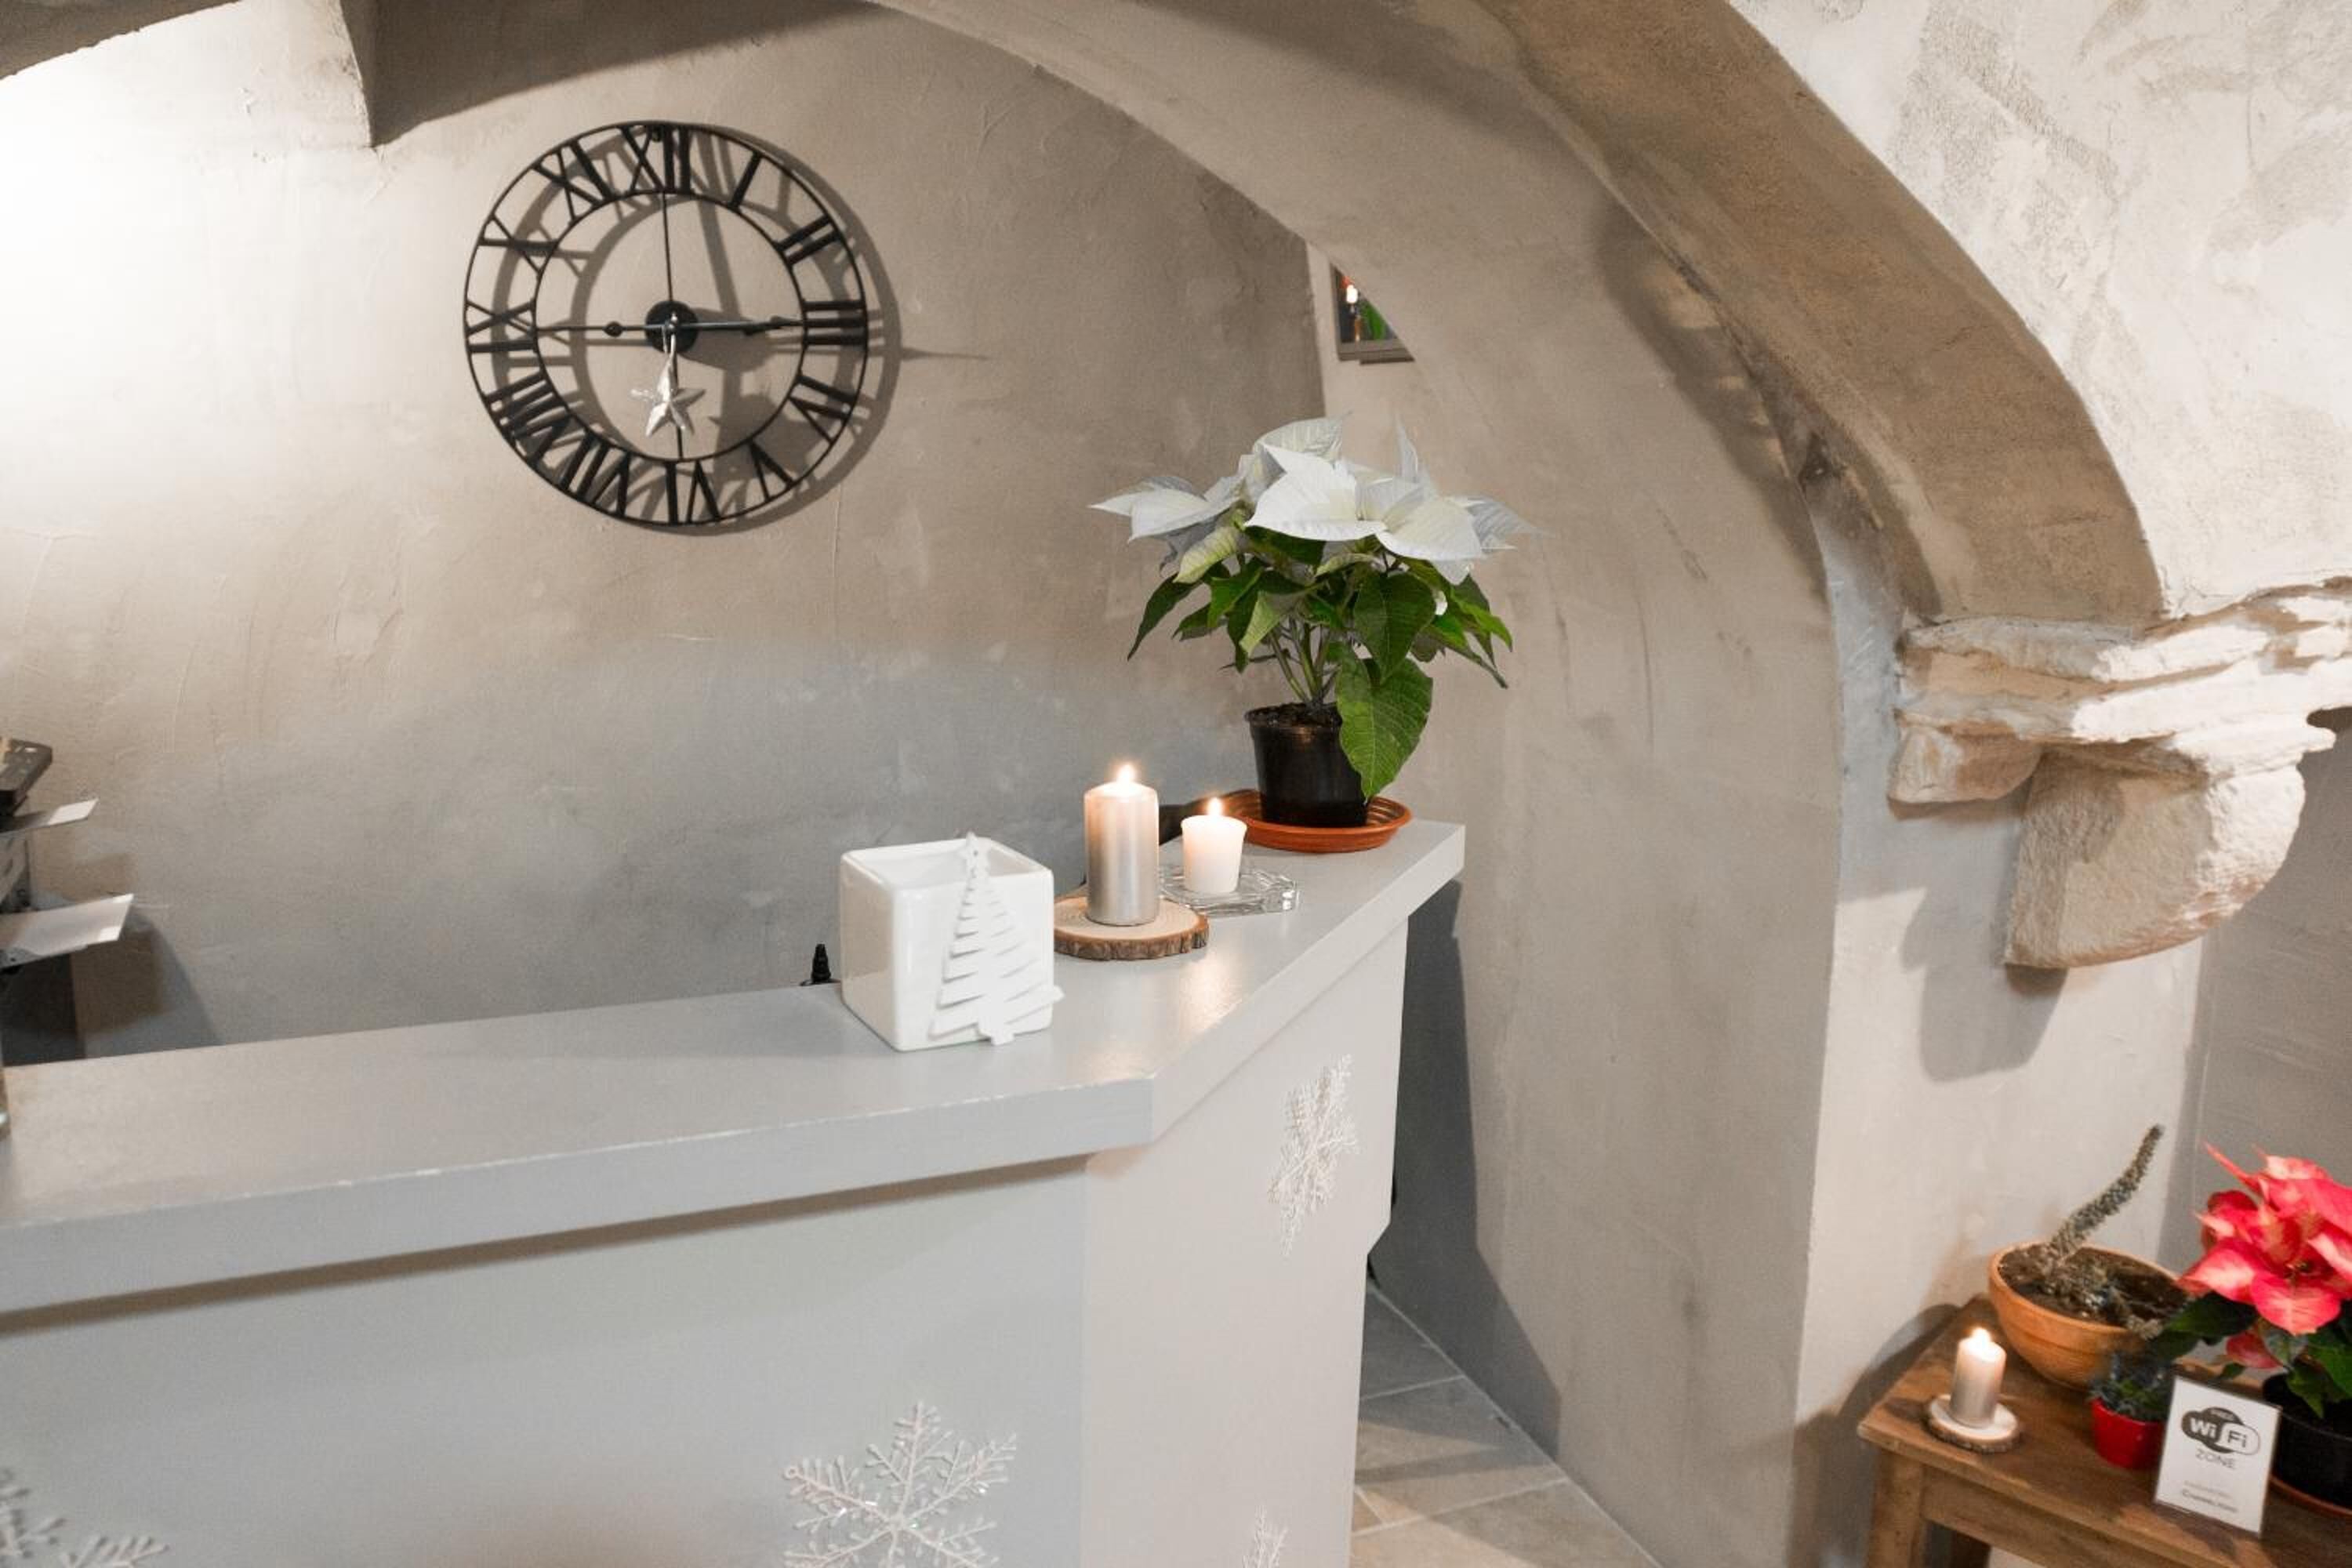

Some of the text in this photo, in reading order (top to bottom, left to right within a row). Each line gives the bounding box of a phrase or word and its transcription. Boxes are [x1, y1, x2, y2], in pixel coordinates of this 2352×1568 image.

[534, 141, 616, 224] XI
[621, 125, 691, 193] XII
[731, 152, 764, 211] I
[479, 216, 559, 274] X
[775, 216, 844, 266] II
[466, 300, 535, 354] IX
[803, 299, 867, 346] III
[789, 374, 856, 444] IV
[665, 461, 720, 524] VI
[750, 441, 797, 503] V
[2194, 1448, 2237, 1469] ZONE
